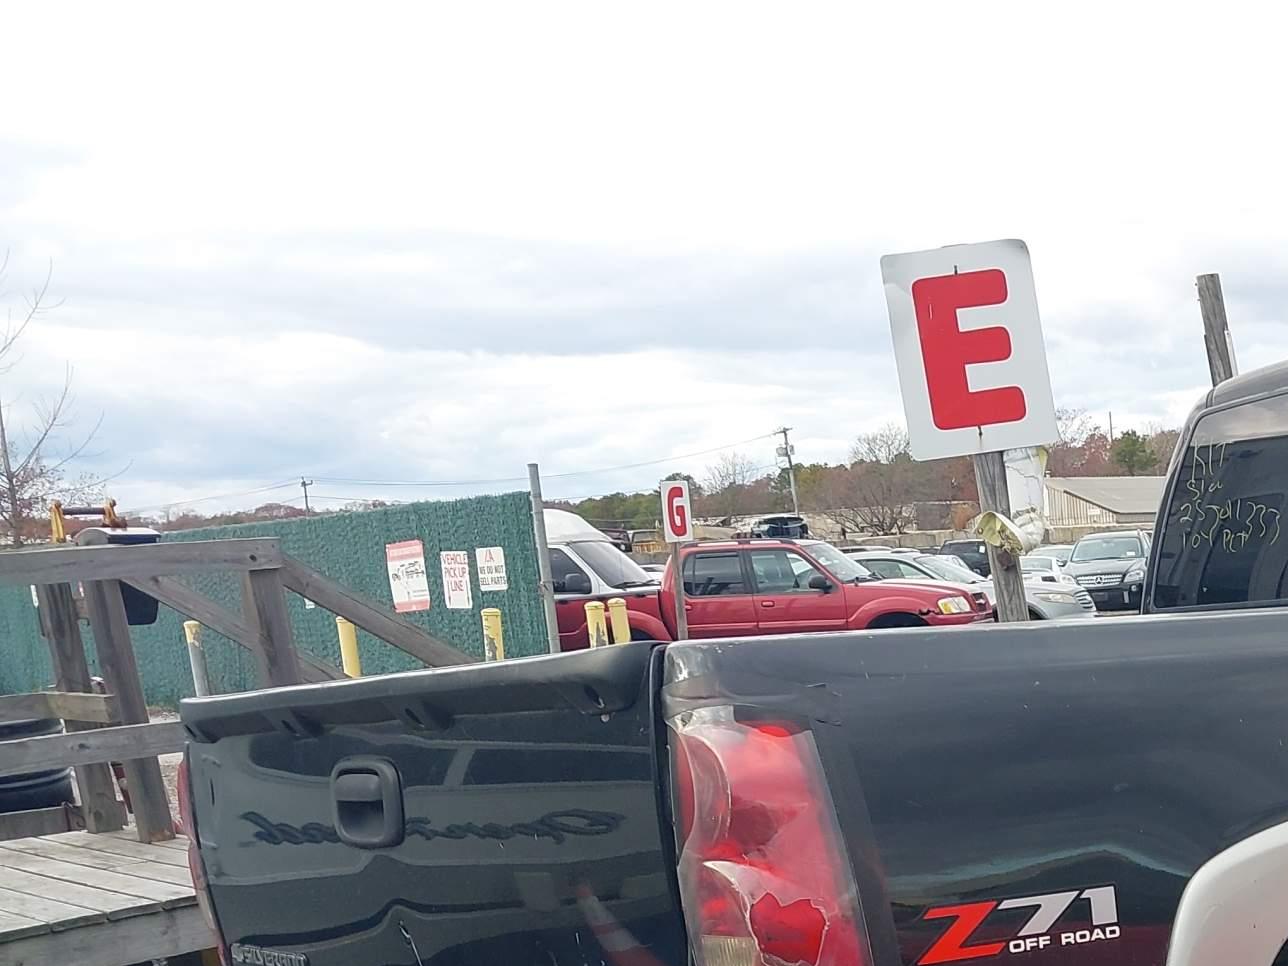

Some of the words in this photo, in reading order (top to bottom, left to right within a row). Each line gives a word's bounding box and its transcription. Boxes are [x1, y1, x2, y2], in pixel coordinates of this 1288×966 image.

[911, 268, 1027, 431] E
[667, 486, 688, 537] G
[441, 553, 468, 565] VEHICLE
[444, 566, 458, 578] PICK
[458, 566, 467, 578] UP
[490, 576, 507, 585] PARTS
[450, 580, 465, 592] LINE
[917, 884, 1120, 966] Z71
[1009, 935, 1051, 954] OFF
[1060, 925, 1121, 946] ROAD
